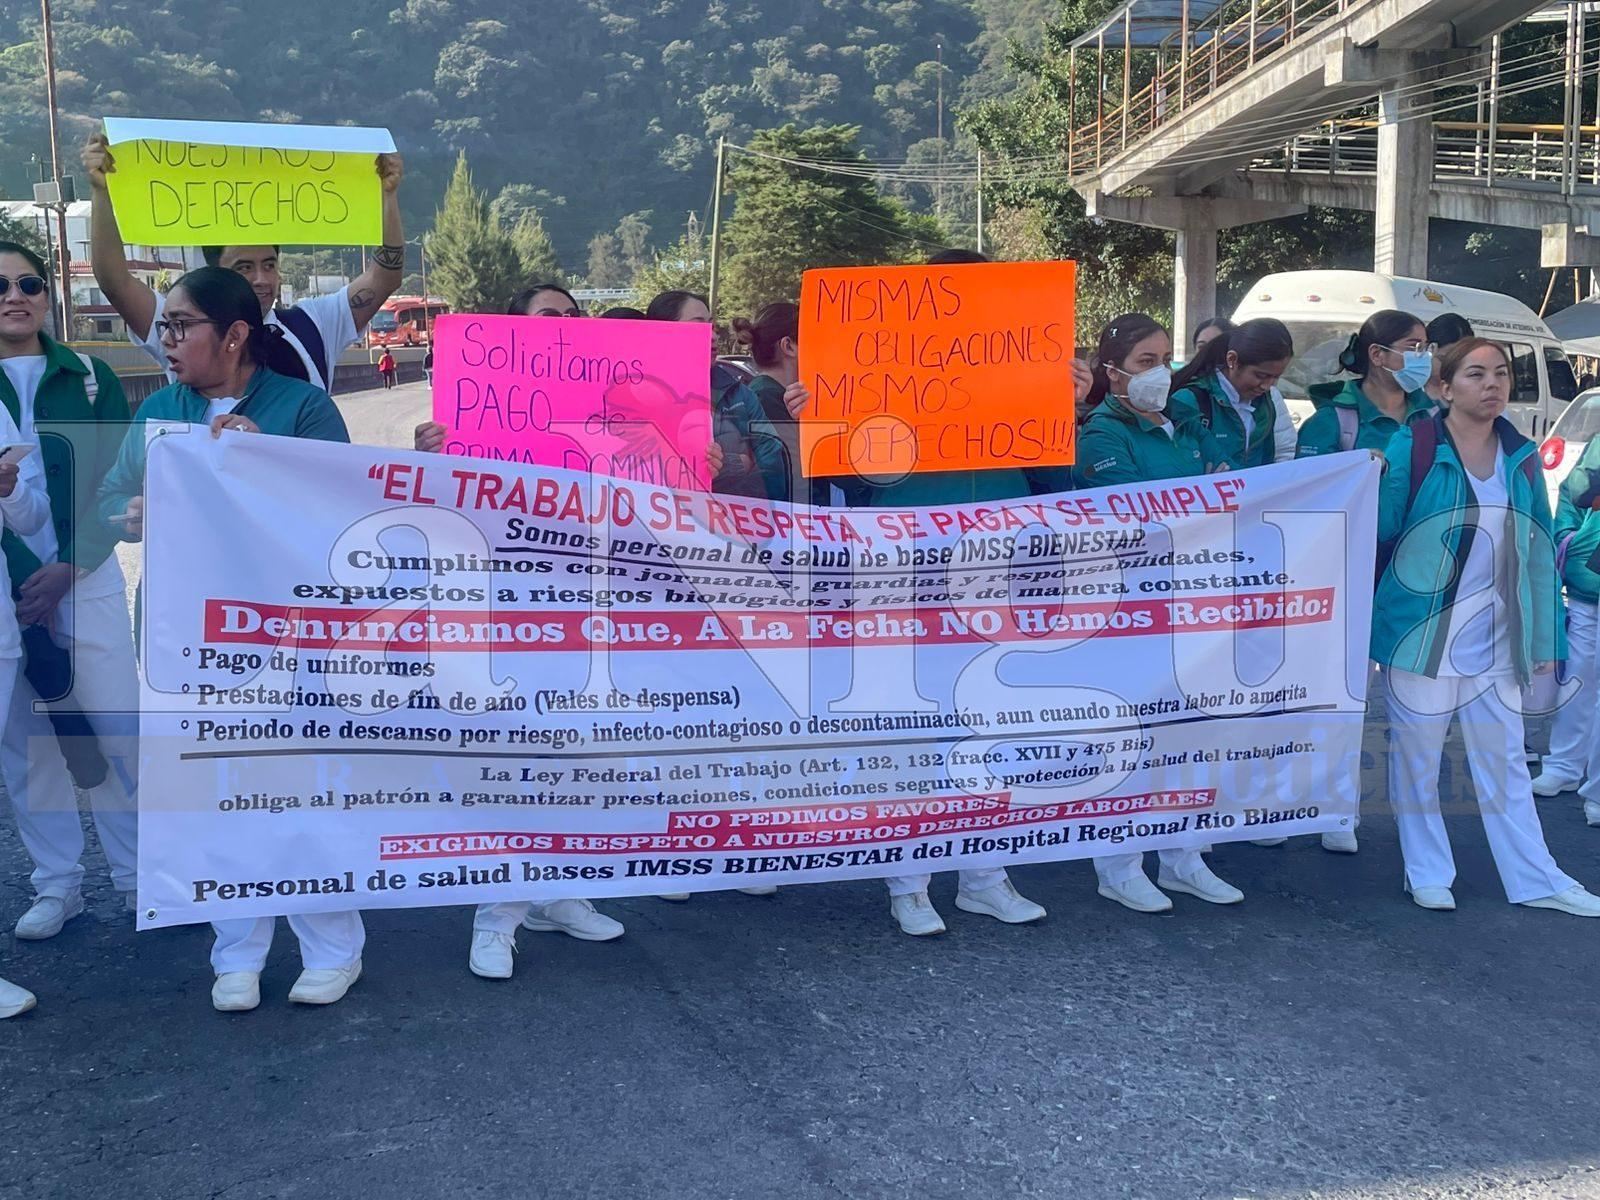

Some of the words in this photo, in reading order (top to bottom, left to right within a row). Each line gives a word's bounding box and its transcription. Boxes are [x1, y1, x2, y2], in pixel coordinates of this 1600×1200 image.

[150, 180, 348, 228] DERECHOS
[817, 275, 960, 323] MISMAS
[461, 322, 643, 385] Solicitamos
[855, 323, 1063, 372] OBLIGACIONES
[455, 377, 552, 432] PAGO
[585, 394, 627, 436] de
[815, 372, 971, 416] MISMOS
[563, 449, 711, 493] DOMINICAL
[452, 470, 635, 527] TRABAJO
[649, 492, 695, 533] SE
[707, 499, 872, 548] RESPETA,
[877, 512, 927, 541] SE
[929, 506, 1027, 536] PAGA
[1024, 503, 1049, 528] Y
[1056, 498, 1104, 526] SE
[506, 518, 601, 549] Somos
[609, 537, 732, 563] personal
[741, 542, 772, 565] de
[781, 545, 851, 568] salud
[860, 547, 888, 568] de
[897, 544, 952, 567] base
[960, 529, 1147, 562] IMSS-BIENESTAR.
[293, 582, 485, 604] expuestos
[497, 589, 518, 603] a
[529, 585, 653, 607] riesgos
[665, 588, 831, 608] biológicos
[839, 597, 857, 609] y
[869, 590, 965, 606] físicos
[975, 586, 1008, 601] de
[1017, 580, 1130, 598] manera
[1139, 570, 1296, 593] constante.
[347, 550, 553, 576] Cumplimos
[566, 562, 628, 577] con
[635, 568, 800, 592] jornadas,
[812, 574, 952, 593] guardias
[959, 575, 978, 587] y
[988, 549, 1254, 582] responsabilidades,
[220, 605, 565, 643] Denunciamos
[581, 615, 683, 646] Que,
[696, 615, 728, 641] A
[737, 615, 793, 641] La
[804, 613, 928, 640] Fecha
[939, 610, 1002, 636] NO
[1015, 609, 1153, 632] Hemos
[1165, 595, 1329, 626] Recibido:
[199, 648, 262, 674] Pago
[270, 651, 298, 673] de
[307, 655, 436, 678] uniformes
[197, 683, 362, 707] Prestaciones
[371, 689, 399, 708] de
[406, 690, 440, 710] fin
[449, 692, 477, 711] de
[484, 690, 527, 711] año
[535, 689, 599, 714] (Vales
[606, 688, 630, 708] de
[636, 686, 740, 712] despensa)
[197, 719, 293, 741] Periodo
[302, 720, 331, 739] de
[339, 720, 452, 741] descanso
[459, 727, 500, 747] por
[507, 724, 585, 749] riesgo,
[592, 717, 783, 743] infecto-contagioso
[789, 720, 801, 734] o
[807, 707, 990, 734] descontaminación,
[996, 707, 1034, 725] aun
[1039, 702, 1110, 723] cuando
[1116, 698, 1180, 718] nuestra
[1185, 692, 1226, 710] labor
[1230, 689, 1244, 706] lo
[1249, 684, 1307, 704] amerita
[219, 793, 302, 813] obliga
[310, 791, 334, 807] al
[343, 787, 430, 809] patrón
[438, 791, 453, 803] a
[461, 789, 596, 807] garantizar
[602, 787, 757, 809] prestaciones,
[764, 780, 888, 800] condiciones
[895, 776, 977, 794] seguras
[984, 777, 996, 790] y
[1002, 763, 1099, 786] protección
[1105, 763, 1115, 774] a
[1120, 758, 1137, 773] la
[1142, 752, 1187, 769] salud
[1192, 749, 1220, 763] del
[1226, 741, 1315, 761] trabajador.
[480, 767, 512, 782] La
[520, 767, 564, 786] Ley
[572, 766, 661, 783] Federal
[669, 764, 702, 780] del
[707, 759, 792, 778] Trabajo
[799, 757, 848, 777] (Art.
[856, 757, 899, 771] 132,
[908, 753, 944, 767] 132
[951, 750, 1009, 765] fracc.
[1015, 744, 1061, 761] XVII
[1067, 747, 1078, 761] y
[1083, 742, 1115, 757] 475
[1120, 736, 1155, 751] Bis)
[380, 835, 553, 855] EXIGIMOS
[563, 834, 716, 850] RESPETO
[723, 834, 746, 848] A
[752, 824, 911, 847] NUESTROS
[917, 806, 1060, 835] DERECHOS
[1063, 792, 1214, 815] LABORALES.
[674, 815, 721, 829] NO
[729, 805, 870, 827] PEDIMOS
[876, 797, 1006, 819] FAVORES.
[192, 872, 355, 902] Personal
[367, 870, 407, 891] de
[418, 863, 510, 888] salud
[522, 862, 614, 881] bases
[624, 858, 713, 878] IMSS
[722, 847, 904, 874] BIENESTAR
[912, 841, 952, 860] del
[960, 827, 1070, 856] Hospital
[1077, 820, 1187, 845] Regional
[1243, 806, 1319, 826] Blanco
